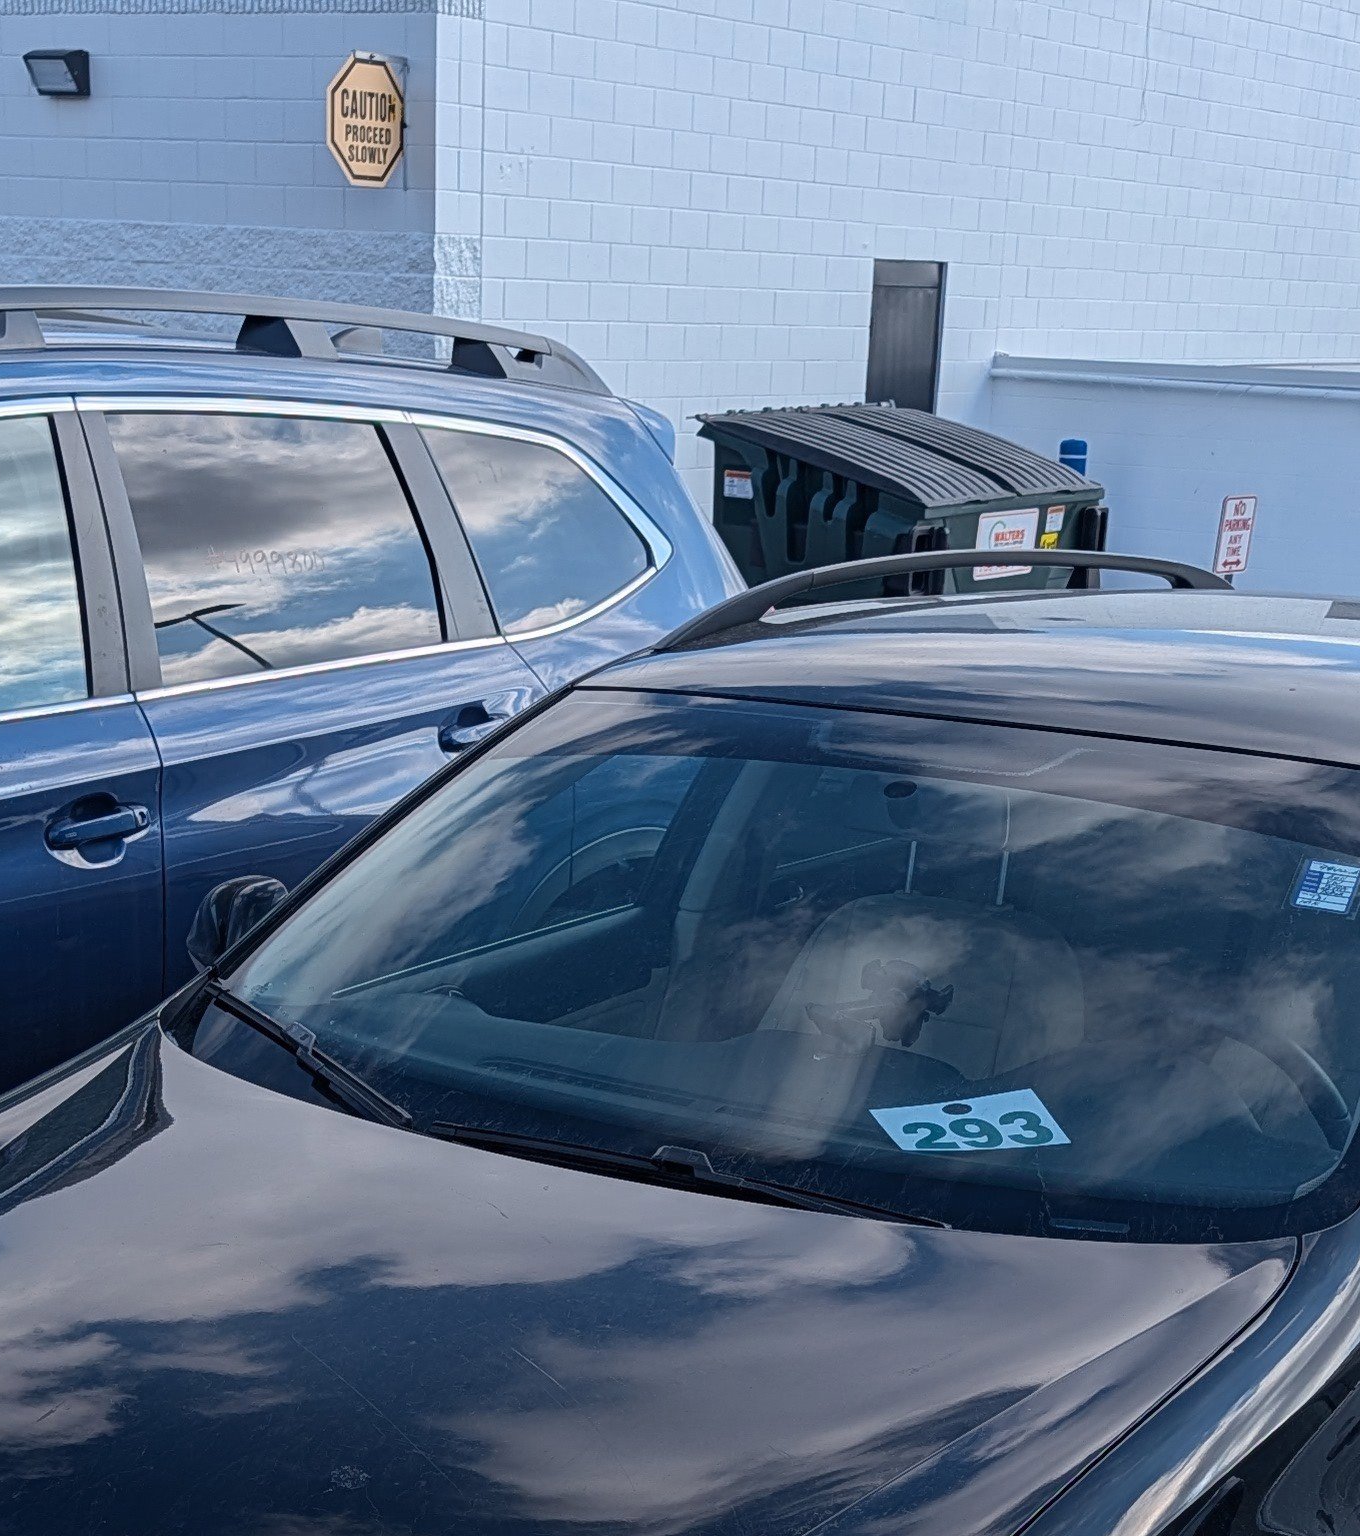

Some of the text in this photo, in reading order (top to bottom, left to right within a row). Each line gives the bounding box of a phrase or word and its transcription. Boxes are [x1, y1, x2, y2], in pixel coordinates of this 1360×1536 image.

[341, 88, 397, 122] CAUTION
[345, 124, 392, 145] PROCEED
[348, 144, 389, 165] SLOWLY
[1233, 500, 1247, 516] NO
[1224, 517, 1252, 532] PARKING
[1228, 533, 1243, 545] ANY
[1226, 546, 1242, 557] TIME
[902, 1110, 1054, 1150] 293
